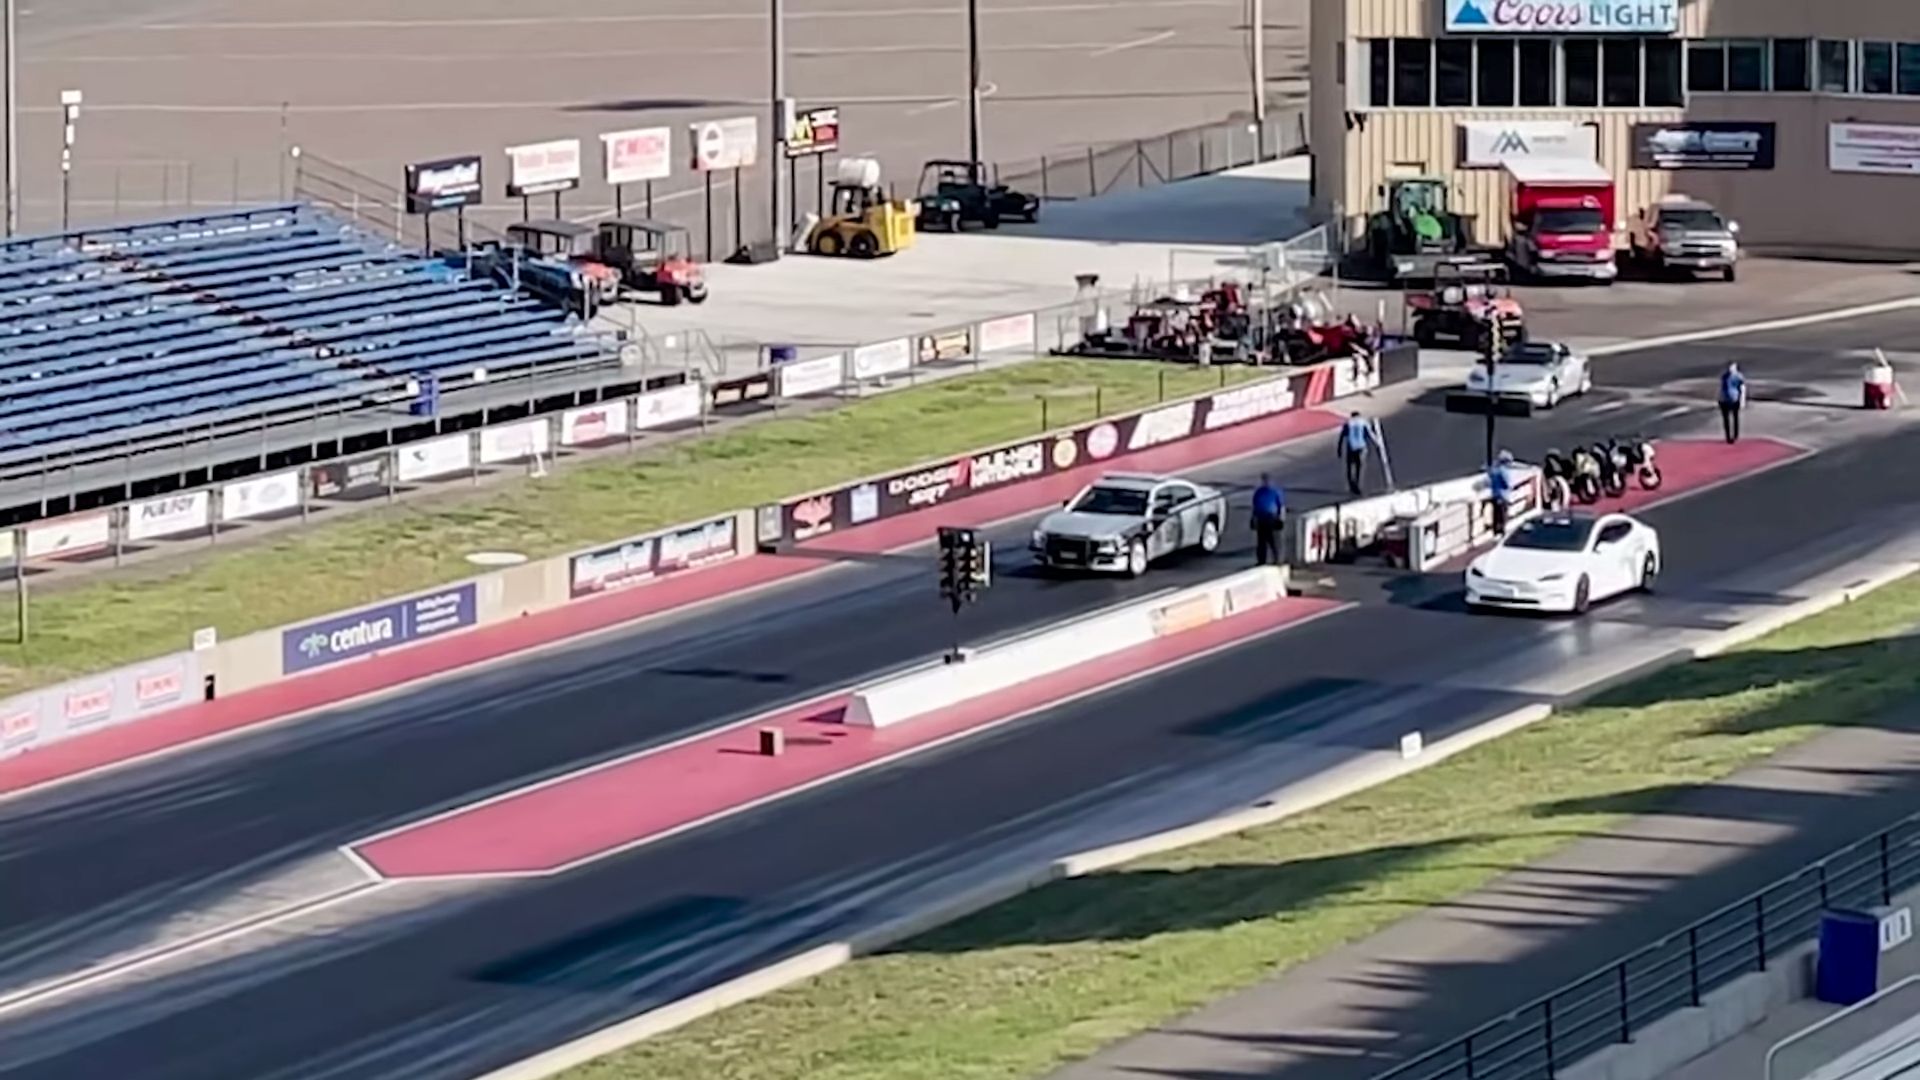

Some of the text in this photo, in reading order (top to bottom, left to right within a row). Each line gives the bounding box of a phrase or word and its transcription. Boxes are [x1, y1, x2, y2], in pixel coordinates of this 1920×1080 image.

[1493, 0, 1672, 25] Coors LIGHT
[888, 464, 959, 494] DODGE
[330, 617, 393, 652] centura
